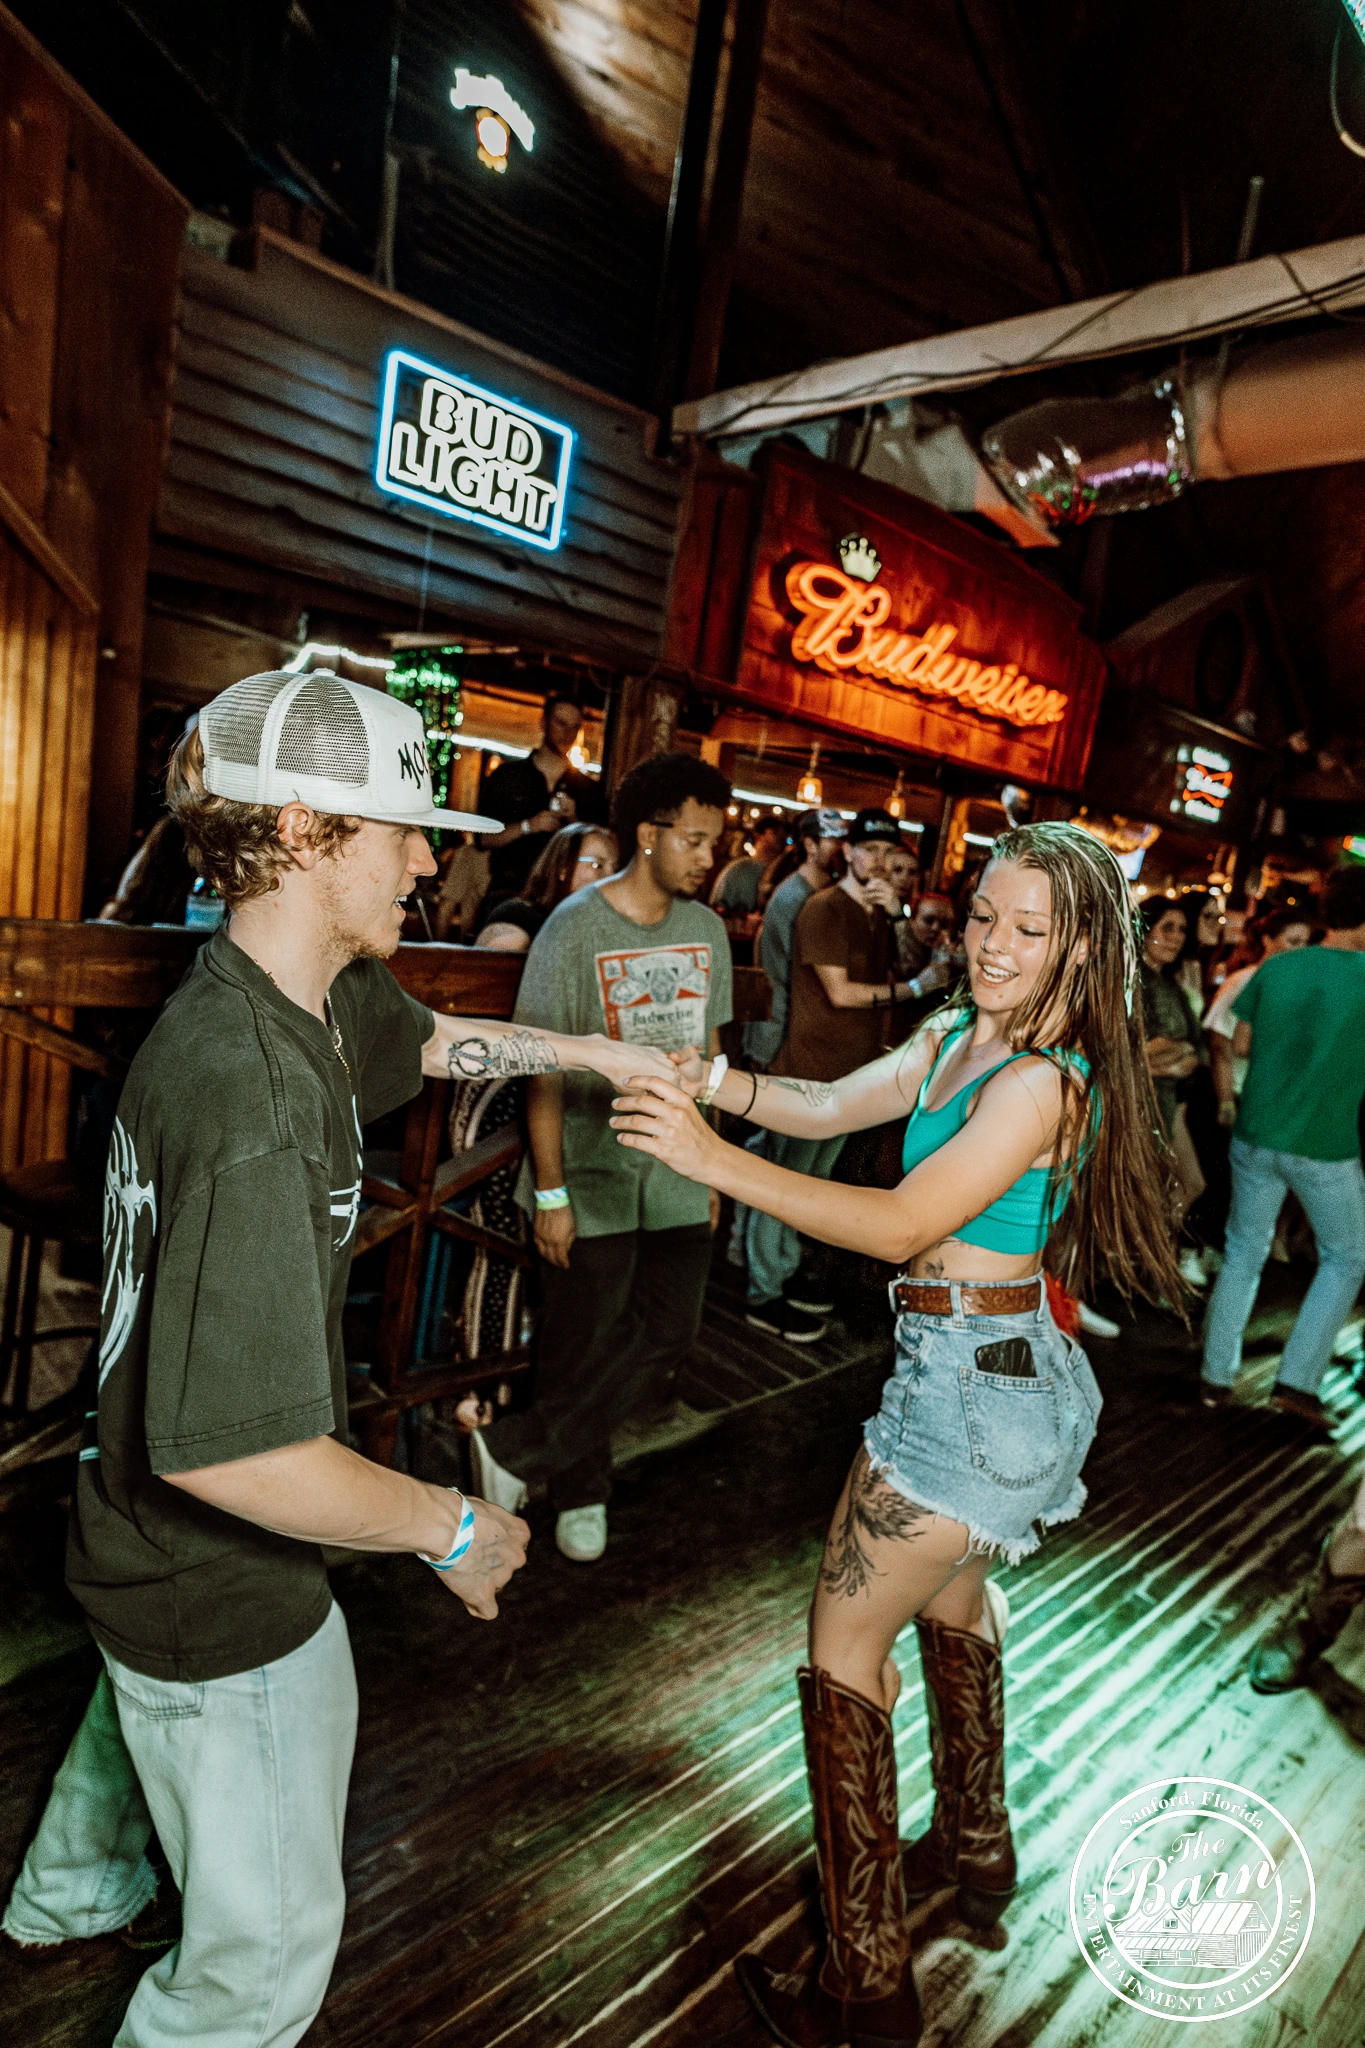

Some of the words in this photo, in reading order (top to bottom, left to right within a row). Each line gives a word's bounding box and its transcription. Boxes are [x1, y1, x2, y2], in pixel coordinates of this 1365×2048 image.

[389, 421, 558, 532] LIGHT
[420, 378, 542, 475] BUD
[785, 561, 1068, 727] Budweiser
